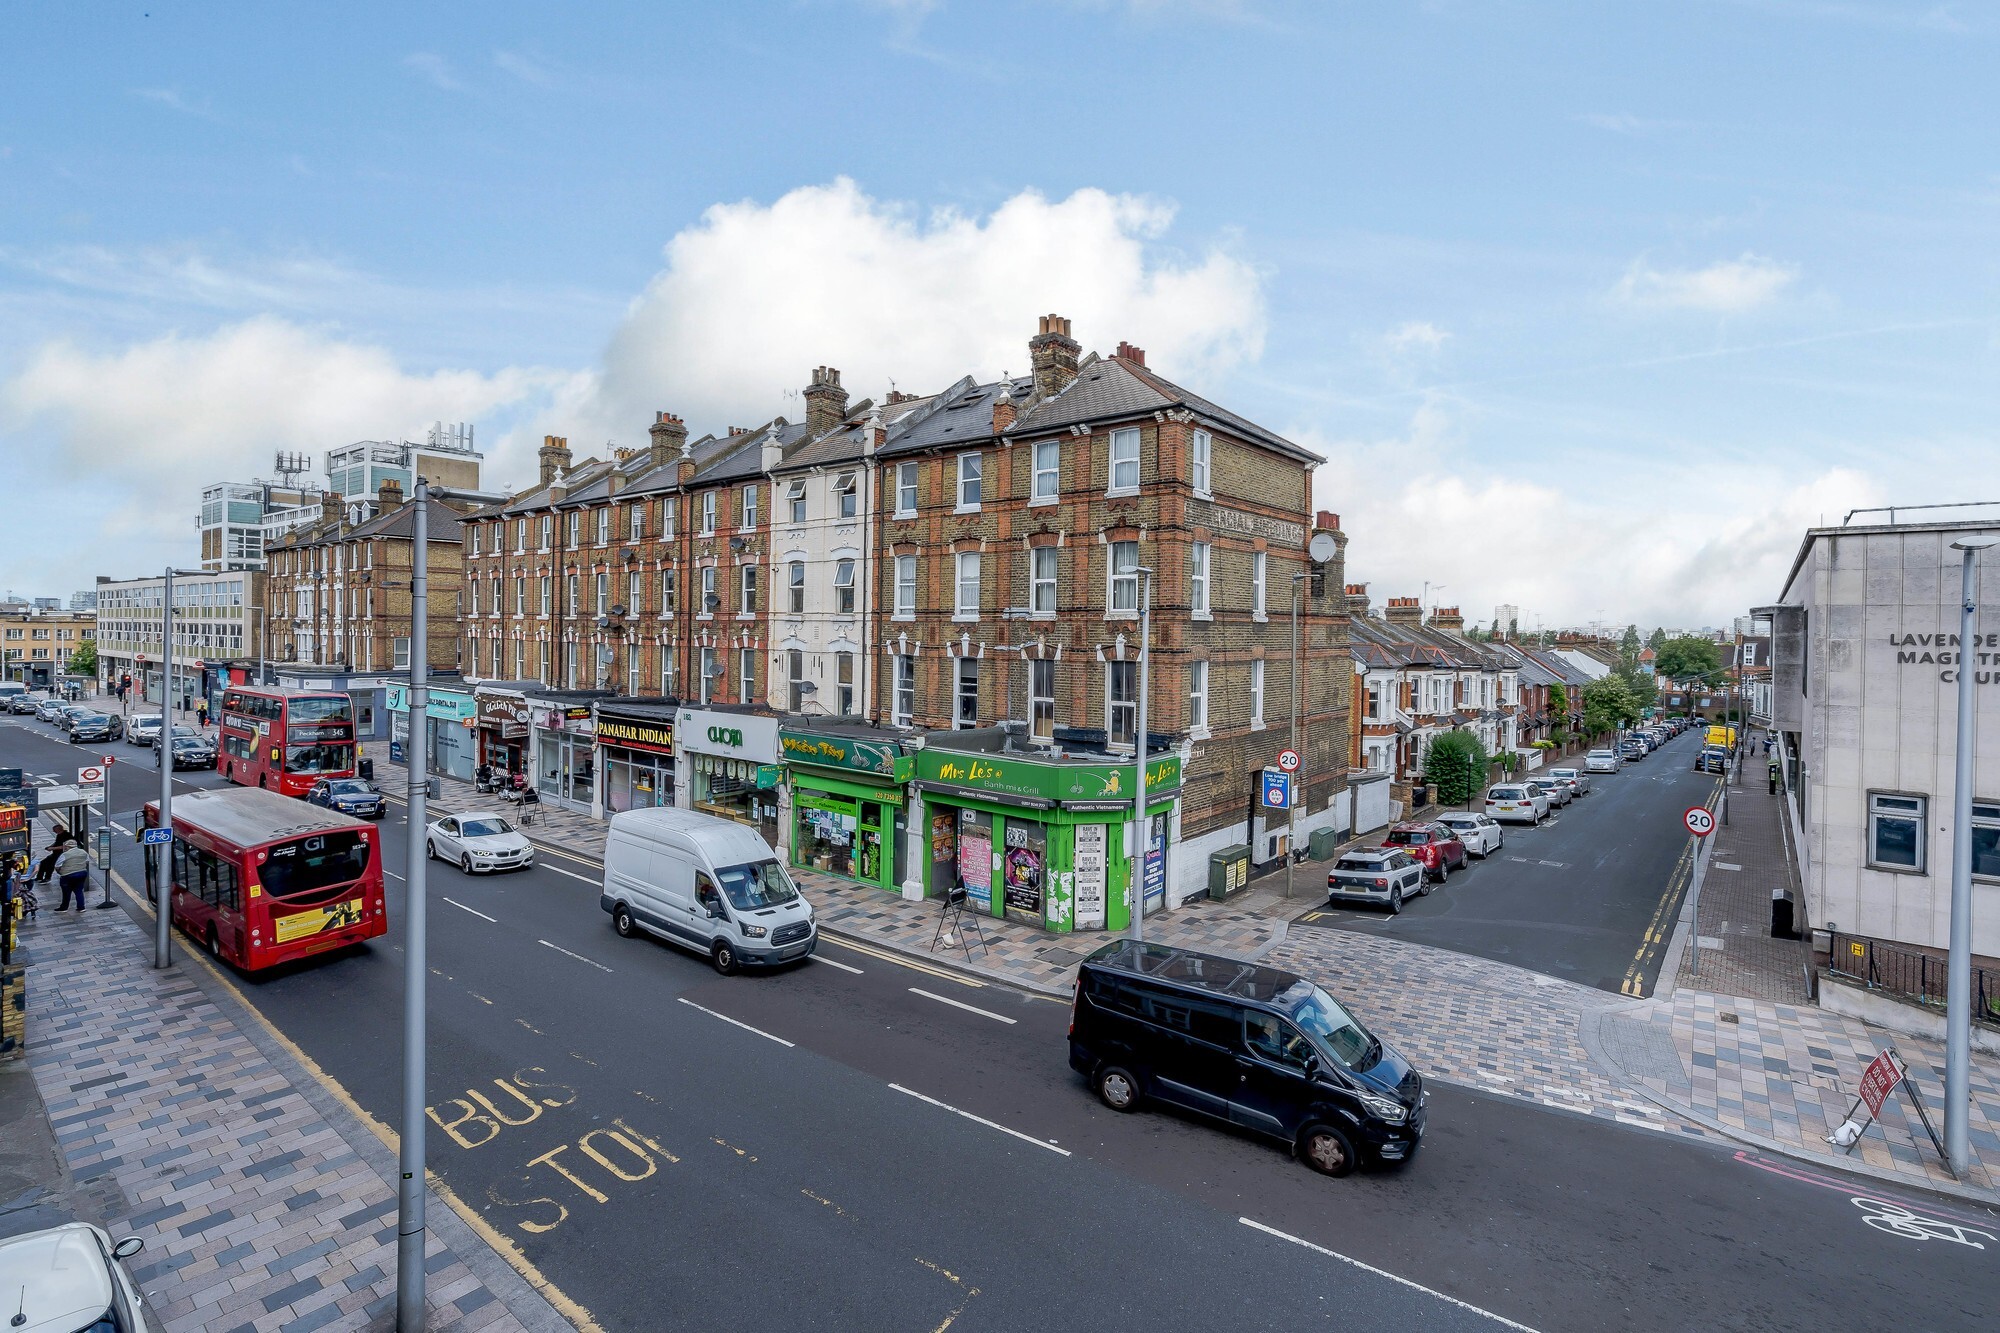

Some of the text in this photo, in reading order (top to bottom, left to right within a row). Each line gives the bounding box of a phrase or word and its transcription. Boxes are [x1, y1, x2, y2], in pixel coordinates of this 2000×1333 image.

[1897, 652, 2000, 666] MAGITR
[486, 701, 508, 713] GOLDEN
[332, 728, 344, 736] 345
[598, 722, 672, 746] PANAHAR INDIAN
[105, 756, 112, 764] E
[1282, 755, 1297, 765] 20
[940, 763, 965, 779] Mrs
[968, 761, 993, 780] Le's
[958, 790, 999, 801] Authentic Vietnamese
[1023, 786, 1039, 795] Grill
[0, 811, 21, 820] DONT
[1689, 814, 1710, 827] 20
[0, 820, 22, 829] WALK
[1, 836, 24, 846] WALK
[1872, 1066, 1887, 1088] DO NOT
[1866, 1073, 1883, 1102] OVERTAKE
[1862, 1083, 1877, 1111] CYCLISTS
[425, 1066, 577, 1149] BUS
